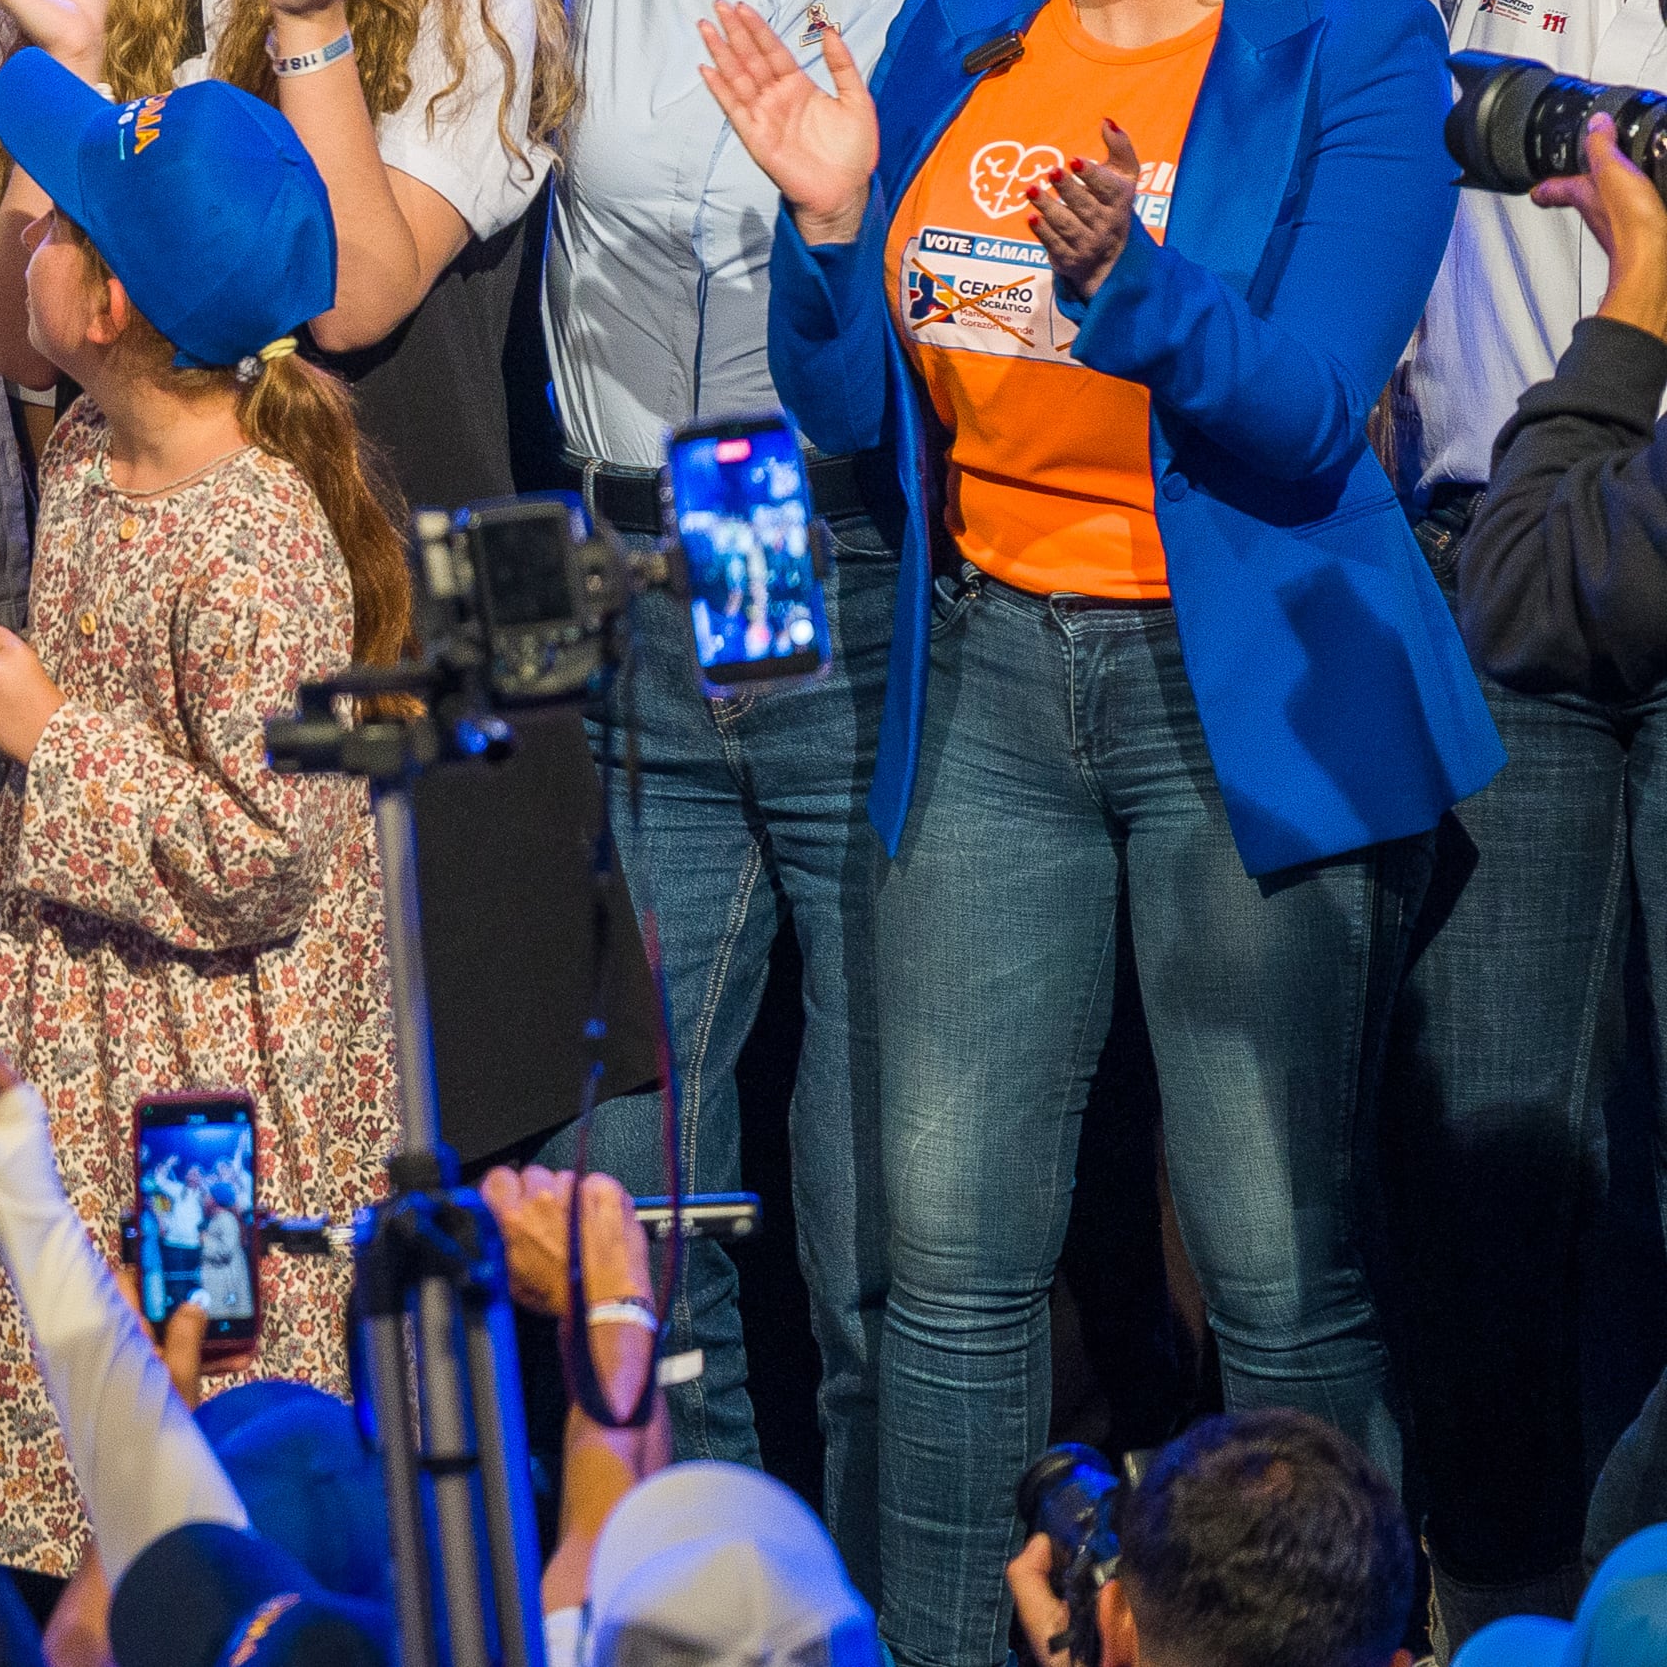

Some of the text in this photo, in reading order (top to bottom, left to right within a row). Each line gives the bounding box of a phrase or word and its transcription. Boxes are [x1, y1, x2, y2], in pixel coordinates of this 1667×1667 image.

[924, 231, 972, 256] VOTE:
[958, 278, 1034, 304] CENTRO
[960, 316, 1000, 331] Corazón
